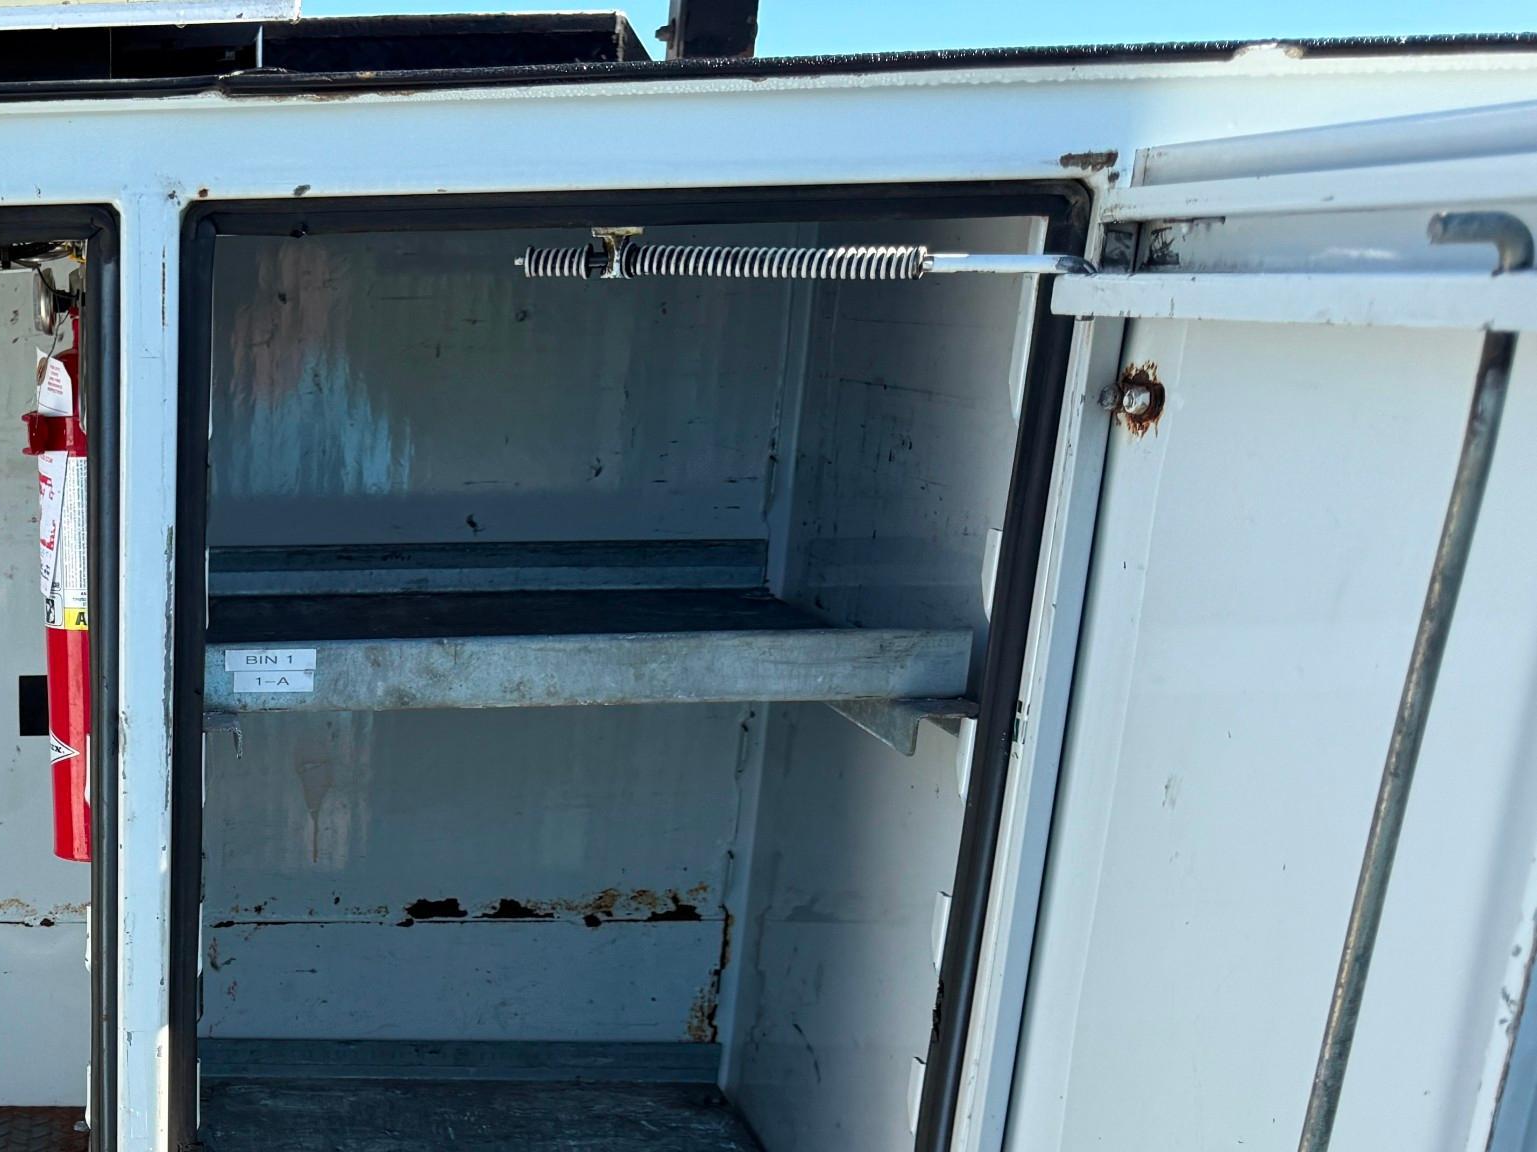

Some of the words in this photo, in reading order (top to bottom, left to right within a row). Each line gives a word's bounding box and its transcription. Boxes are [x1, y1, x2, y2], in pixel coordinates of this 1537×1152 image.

[245, 655, 278, 665] BIN
[286, 655, 293, 664] 1
[255, 676, 290, 686] 1-A
